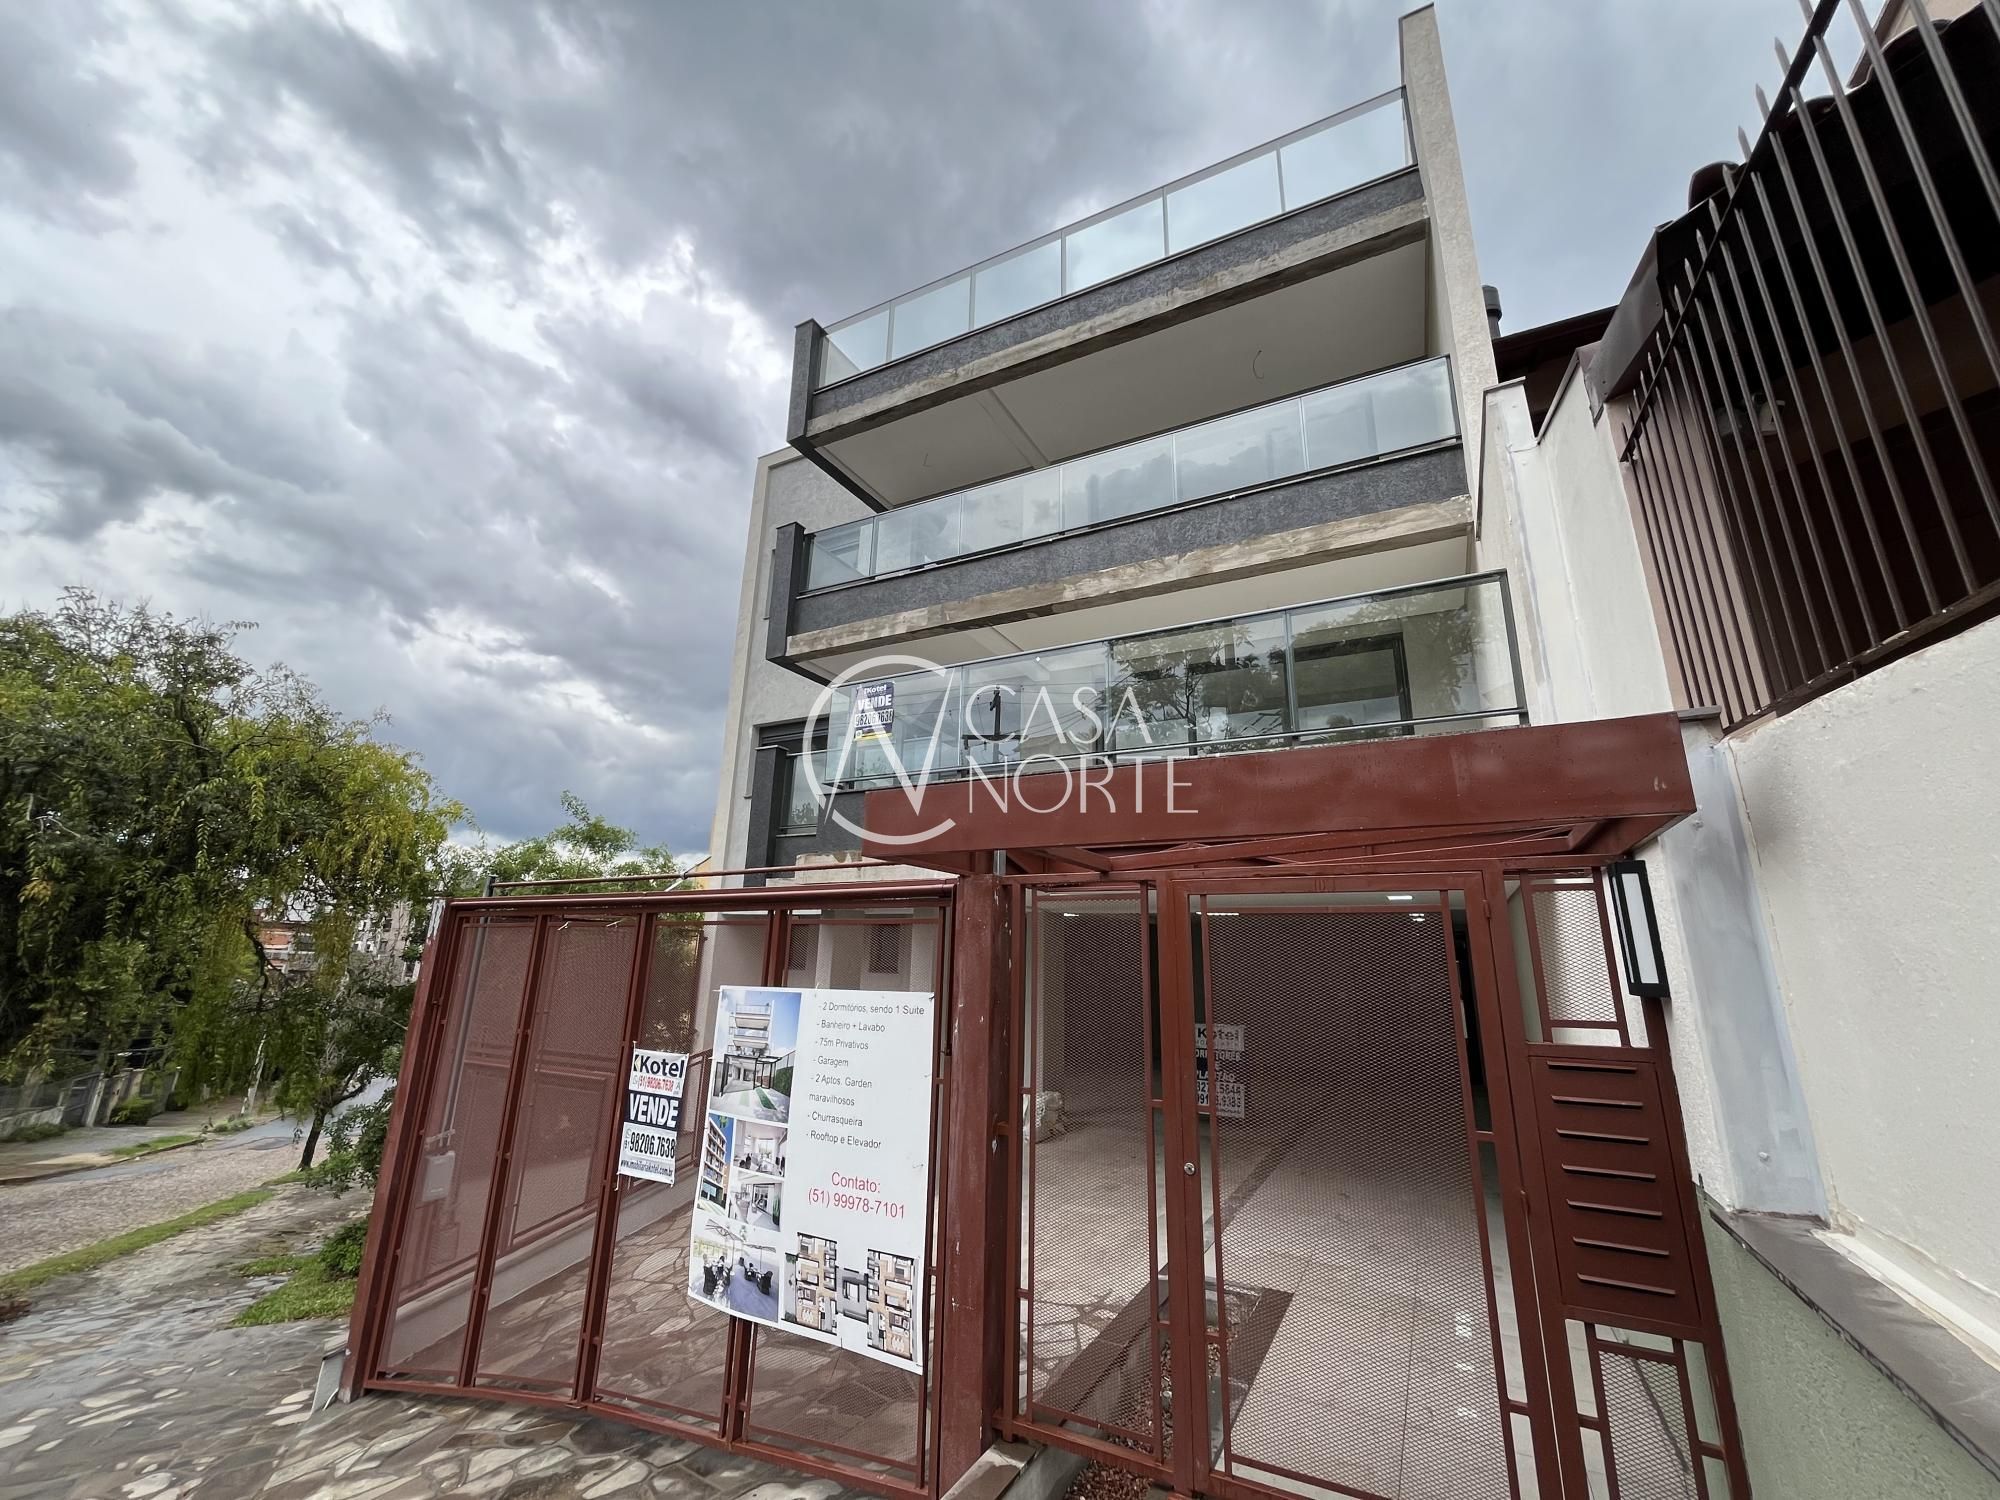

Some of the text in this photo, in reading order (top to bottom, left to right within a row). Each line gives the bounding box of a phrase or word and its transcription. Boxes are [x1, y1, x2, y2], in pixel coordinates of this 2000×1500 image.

[858, 694, 892, 711] VENDE
[870, 1005, 893, 1014] sendo
[821, 1020, 850, 1030] Banheiro
[858, 1022, 885, 1032] Lavabo
[835, 1039, 869, 1050] Privativos
[817, 1055, 849, 1068] Garagem
[845, 1077, 873, 1089] Garden
[809, 1093, 855, 1106] maravilhosos
[629, 1093, 679, 1128] VENDE
[811, 1111, 863, 1127] Churrasqueira
[629, 1131, 676, 1159] 98206.7638
[810, 1130, 839, 1144] Rooftop
[847, 1136, 882, 1149] Elevador
[831, 1171, 881, 1194] Contato:
[808, 1187, 906, 1220] (51) 99978-7101
